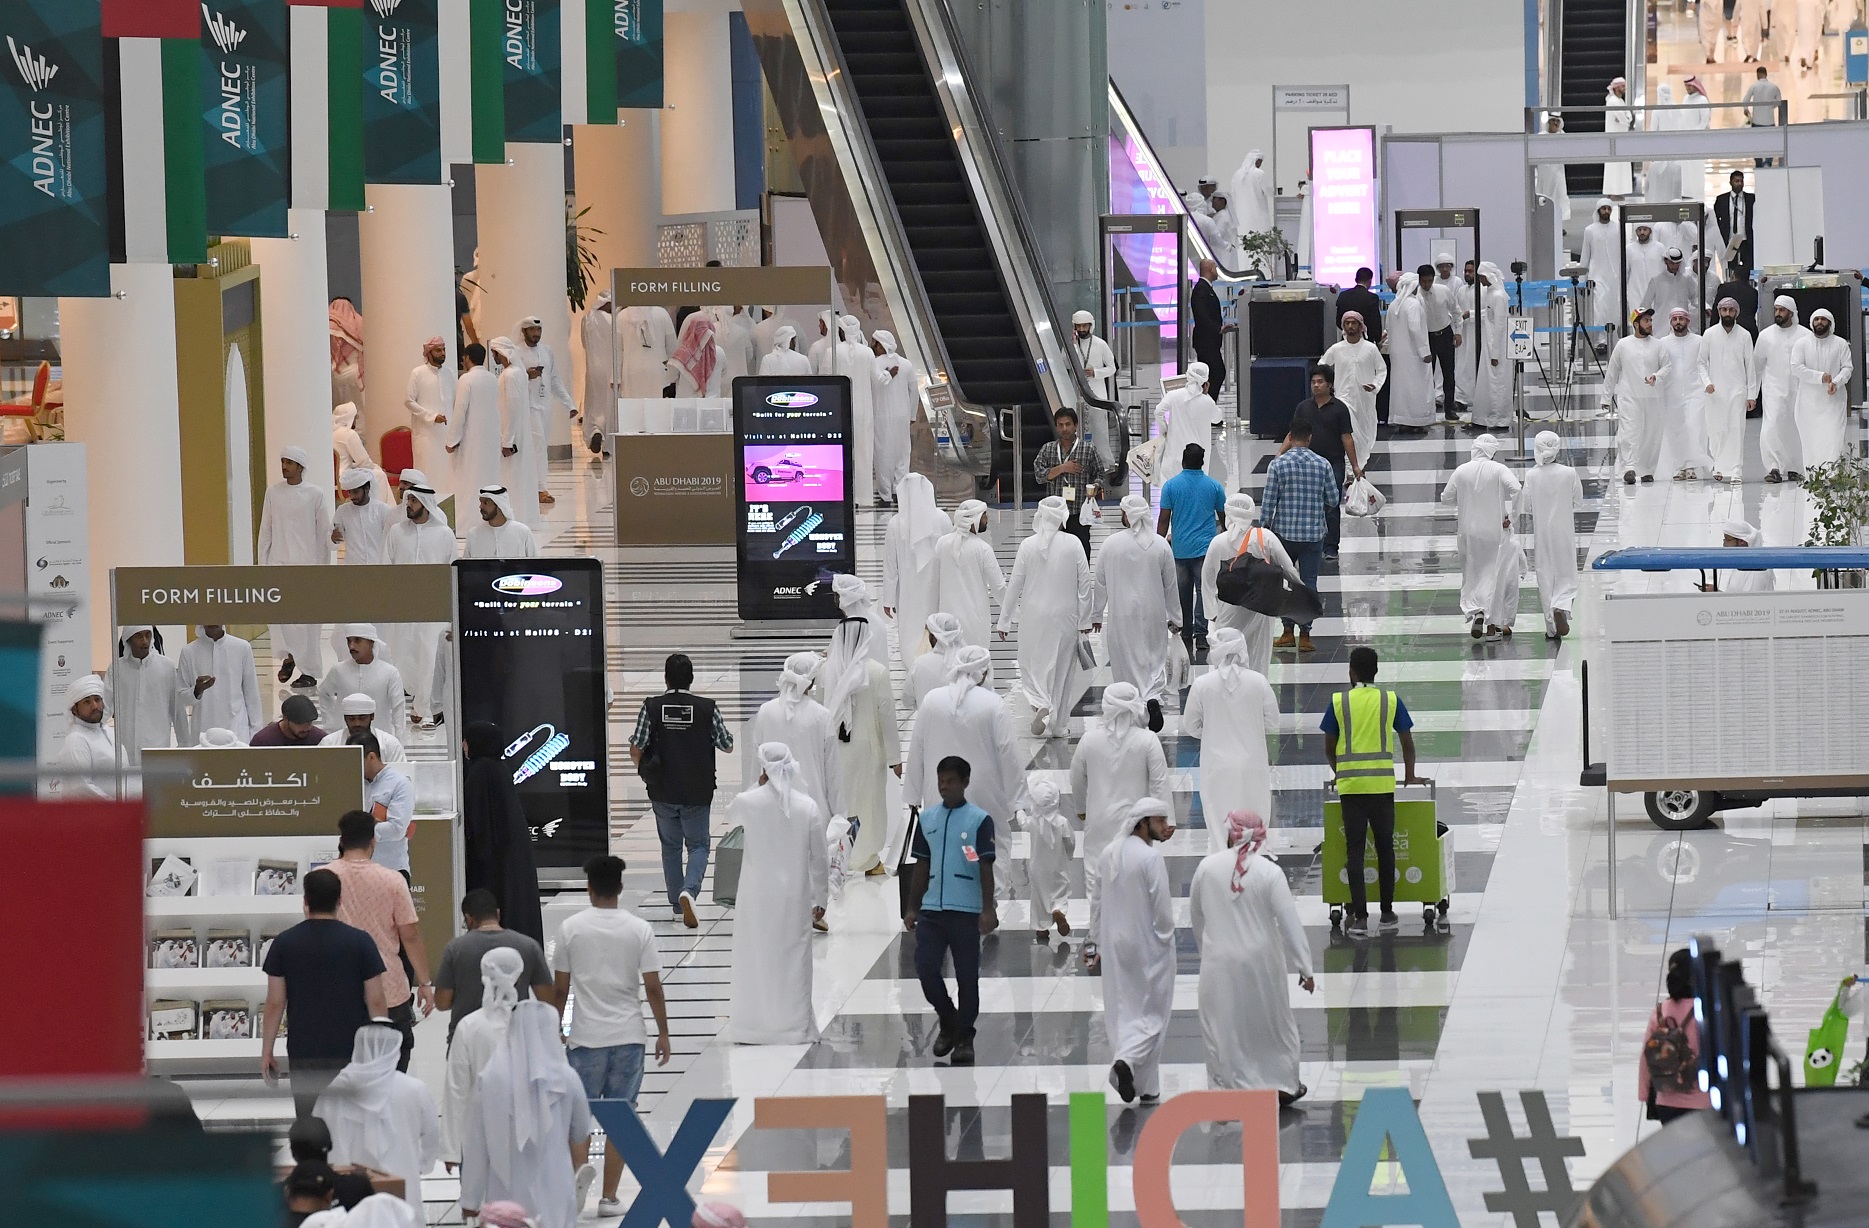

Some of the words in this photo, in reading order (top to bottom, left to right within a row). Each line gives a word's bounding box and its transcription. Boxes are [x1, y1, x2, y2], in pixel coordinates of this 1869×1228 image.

[506, 0, 523, 70] ADNEC
[378, 25, 398, 105] ADNEC
[221, 61, 241, 149] ADNEC
[31, 100, 55, 198] ADNEC
[1319, 184, 1369, 198] ADVERT
[630, 282, 668, 293] FORM
[672, 281, 722, 292] FILLING
[1515, 320, 1528, 331] EXIT
[1515, 341, 1527, 355] خروج
[786, 411, 802, 419] your
[654, 477, 672, 486] ABU
[672, 477, 700, 486] DHABI
[700, 477, 722, 485] 2019
[141, 588, 199, 604] FORM
[206, 587, 282, 604] FILLING
[773, 586, 802, 595] ADNEC
[519, 601, 540, 609] your
[541, 600, 574, 608] terrain
[42, 611, 64, 619] ADNEC
[1753, 609, 1771, 617] 2019
[509, 629, 520, 637] at
[191, 768, 307, 789] اكتشف
[180, 798, 227, 808] والفروسية
[227, 798, 259, 808] للصيد
[259, 798, 293, 807] معرض
[293, 796, 321, 806] أكبر
[202, 808, 237, 818] التراث
[237, 808, 263, 818] على
[264, 808, 300, 817] والحفاظ
